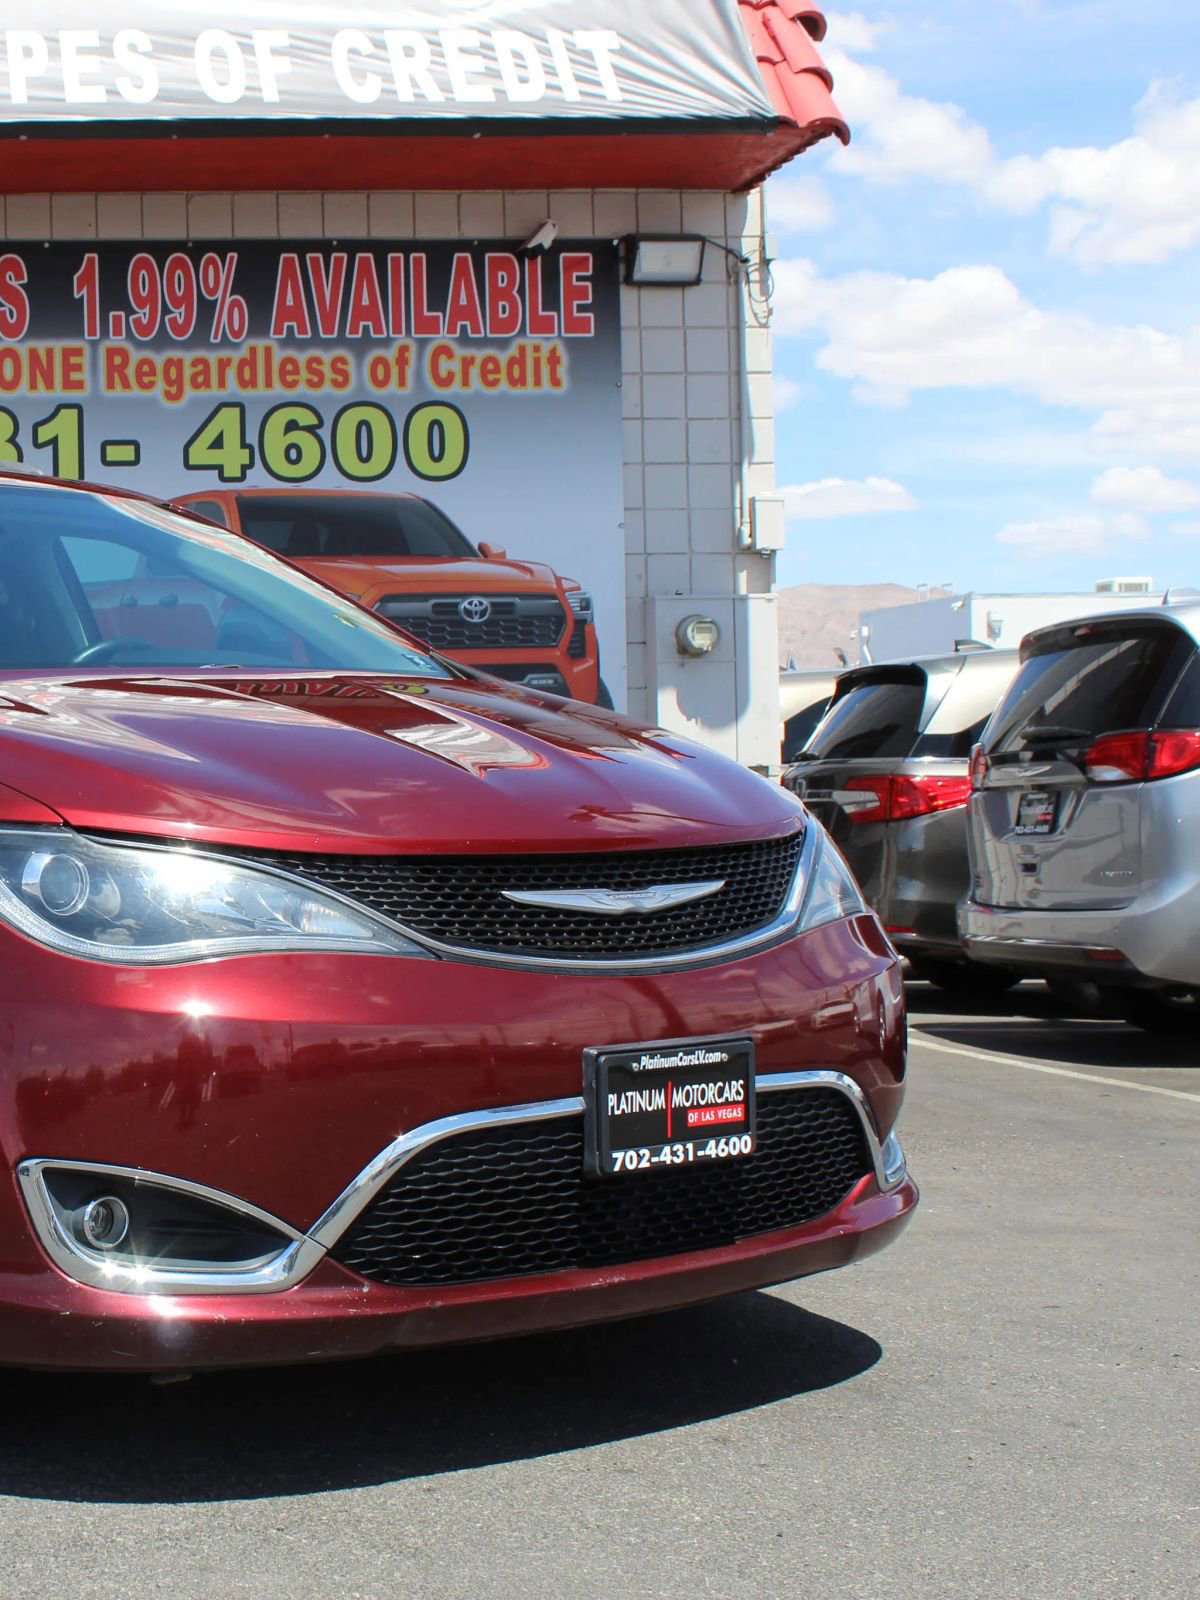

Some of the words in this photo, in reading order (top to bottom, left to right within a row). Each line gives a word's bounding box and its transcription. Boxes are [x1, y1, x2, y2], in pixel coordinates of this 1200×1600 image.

[194, 29, 293, 103] OF
[331, 28, 624, 103] CREDIT
[73, 252, 249, 342] 1.99%
[270, 252, 595, 339] AVAILABLE
[105, 344, 350, 401] Regardless
[369, 342, 411, 390] of
[430, 342, 563, 389] Credit
[183, 401, 470, 484] 4600
[639, 1049, 721, 1071] PlatinumCarsLV.com
[608, 1087, 666, 1116] PLATINUM
[672, 1079, 745, 1109] MOTORCARS
[688, 1112, 699, 1123] OF
[701, 1110, 715, 1121] LAS
[717, 1107, 742, 1119] VEGAS
[611, 1135, 752, 1172] 702-431-4600
